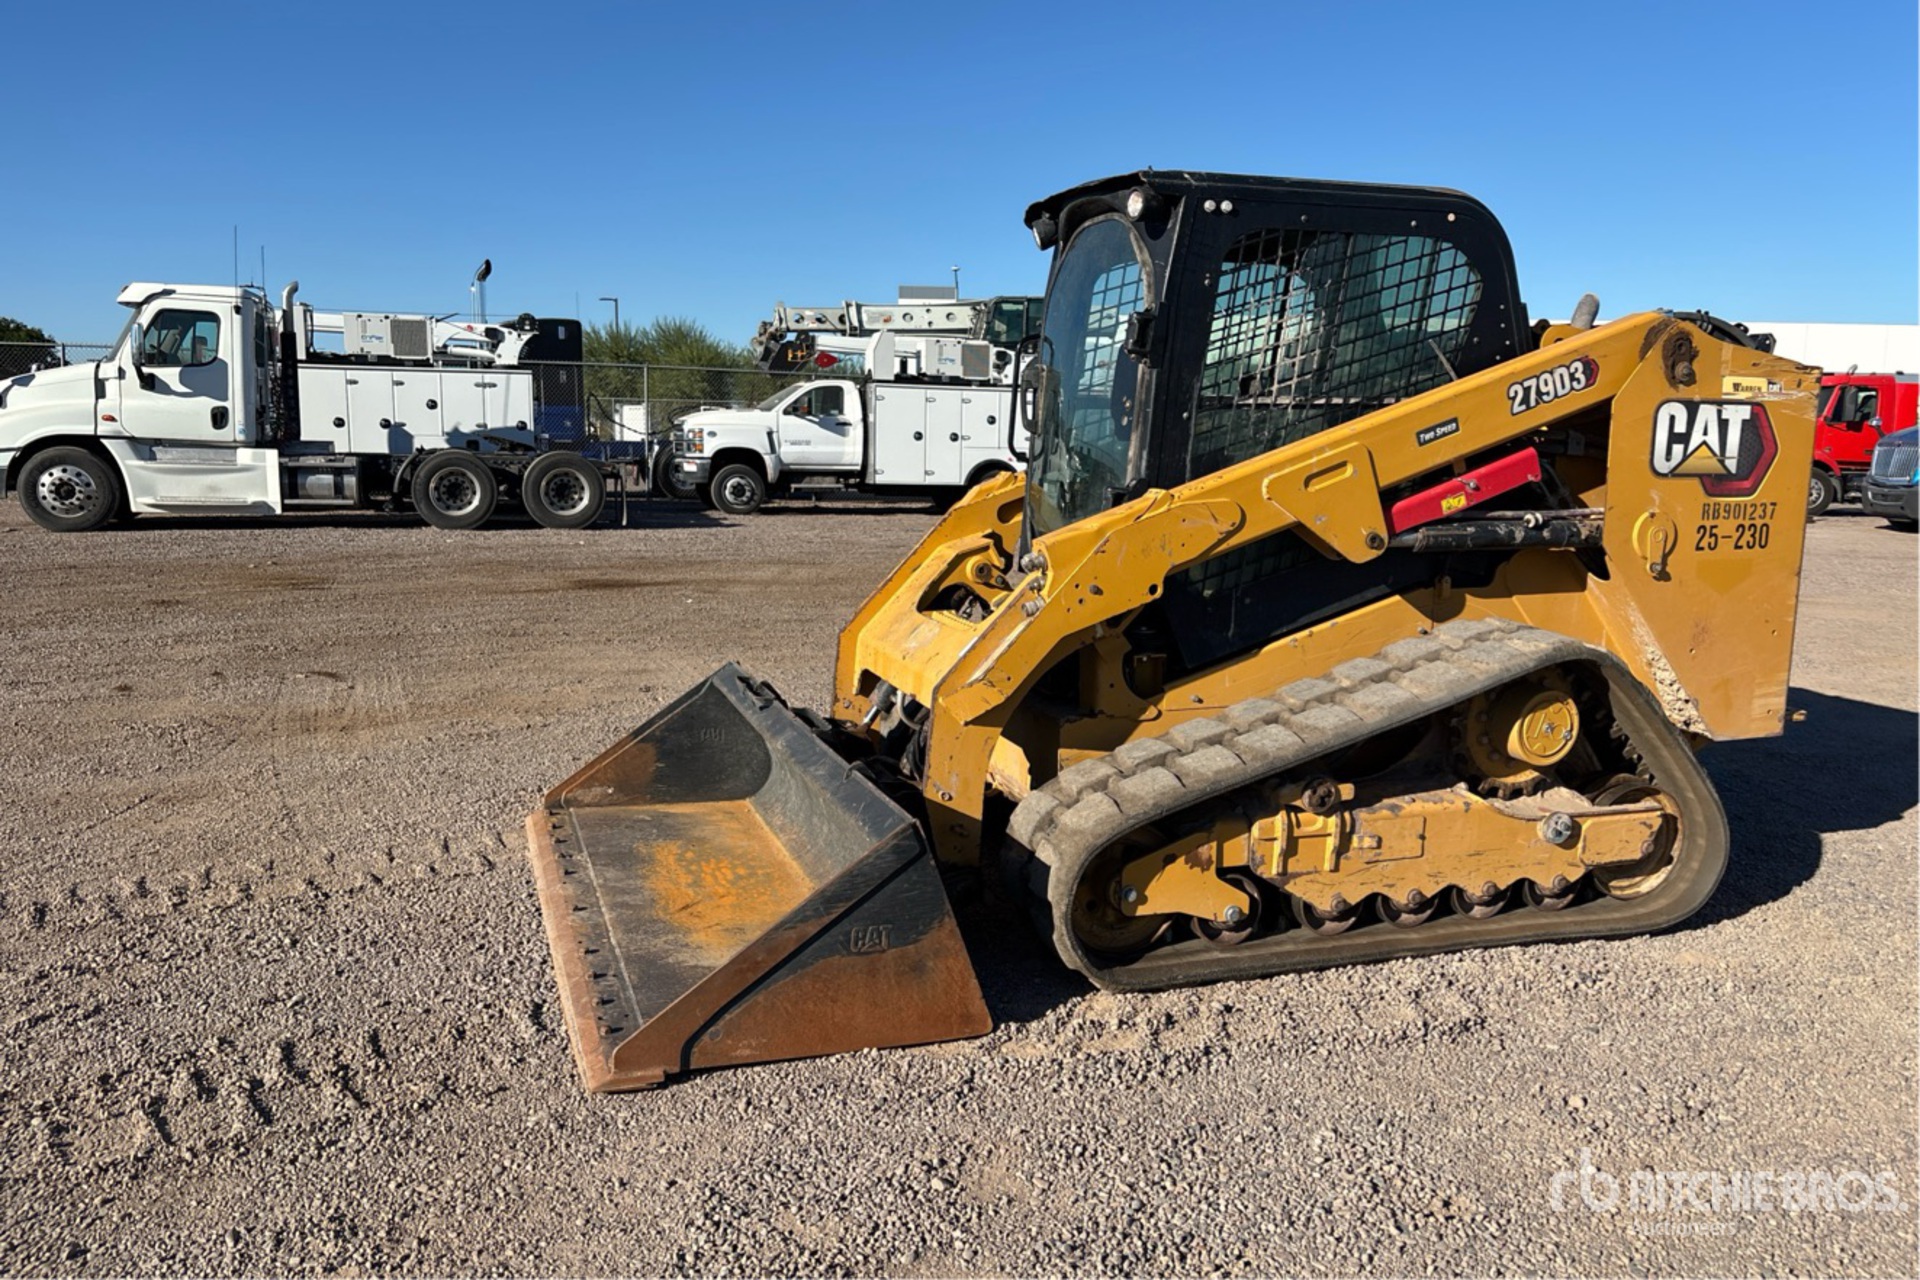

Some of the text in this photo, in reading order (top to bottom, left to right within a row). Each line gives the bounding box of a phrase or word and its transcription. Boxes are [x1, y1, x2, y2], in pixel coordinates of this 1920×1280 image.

[1508, 360, 1587, 415] 279D3
[1653, 401, 1752, 474] CAT
[1695, 523, 1769, 551] 25-230
[850, 924, 894, 953] CAT
